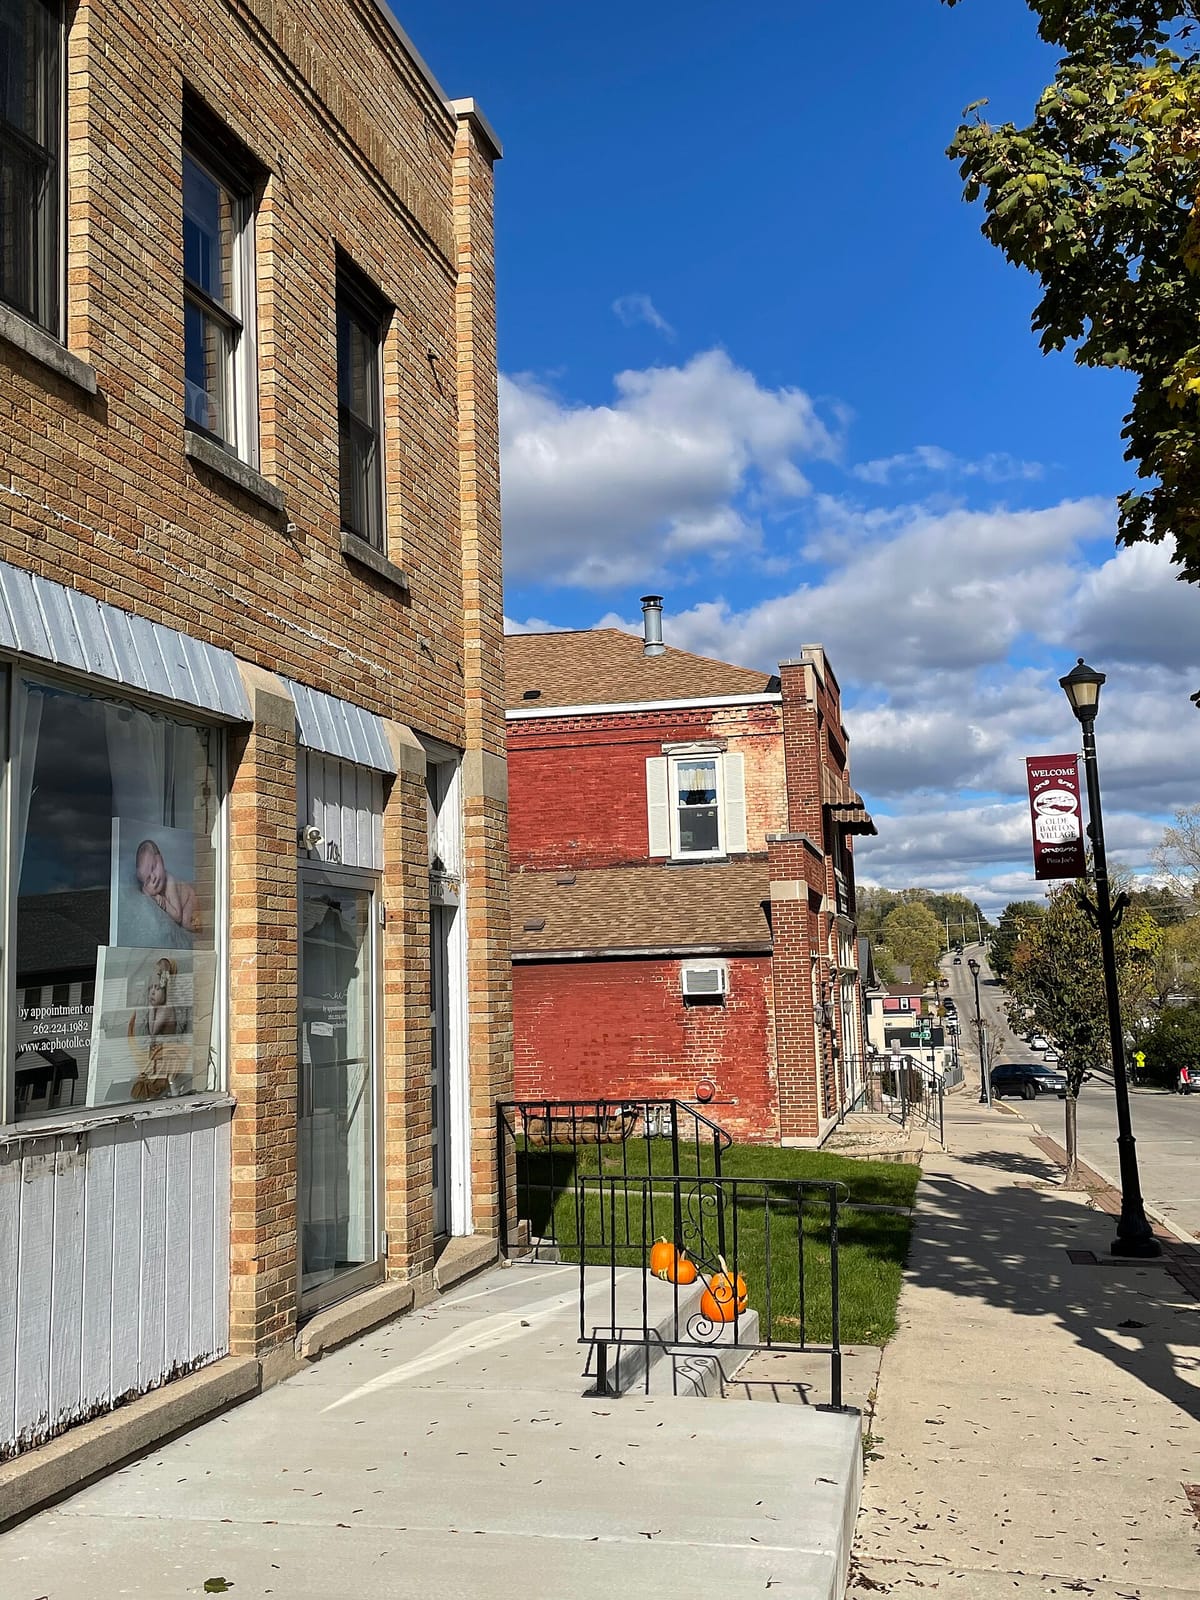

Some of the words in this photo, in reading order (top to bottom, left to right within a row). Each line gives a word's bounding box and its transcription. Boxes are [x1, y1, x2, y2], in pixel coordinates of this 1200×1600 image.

[1031, 768, 1075, 777] WELCOME
[1045, 817, 1069, 825] OLDE
[1040, 824, 1075, 832] BARTON
[1040, 831, 1076, 839] VILLAGE
[18, 1005, 29, 1020] by
[30, 1004, 84, 1019] appointment
[33, 1020, 88, 1035] 262.224.1982
[17, 1036, 91, 1053] www.acphotollc.co
